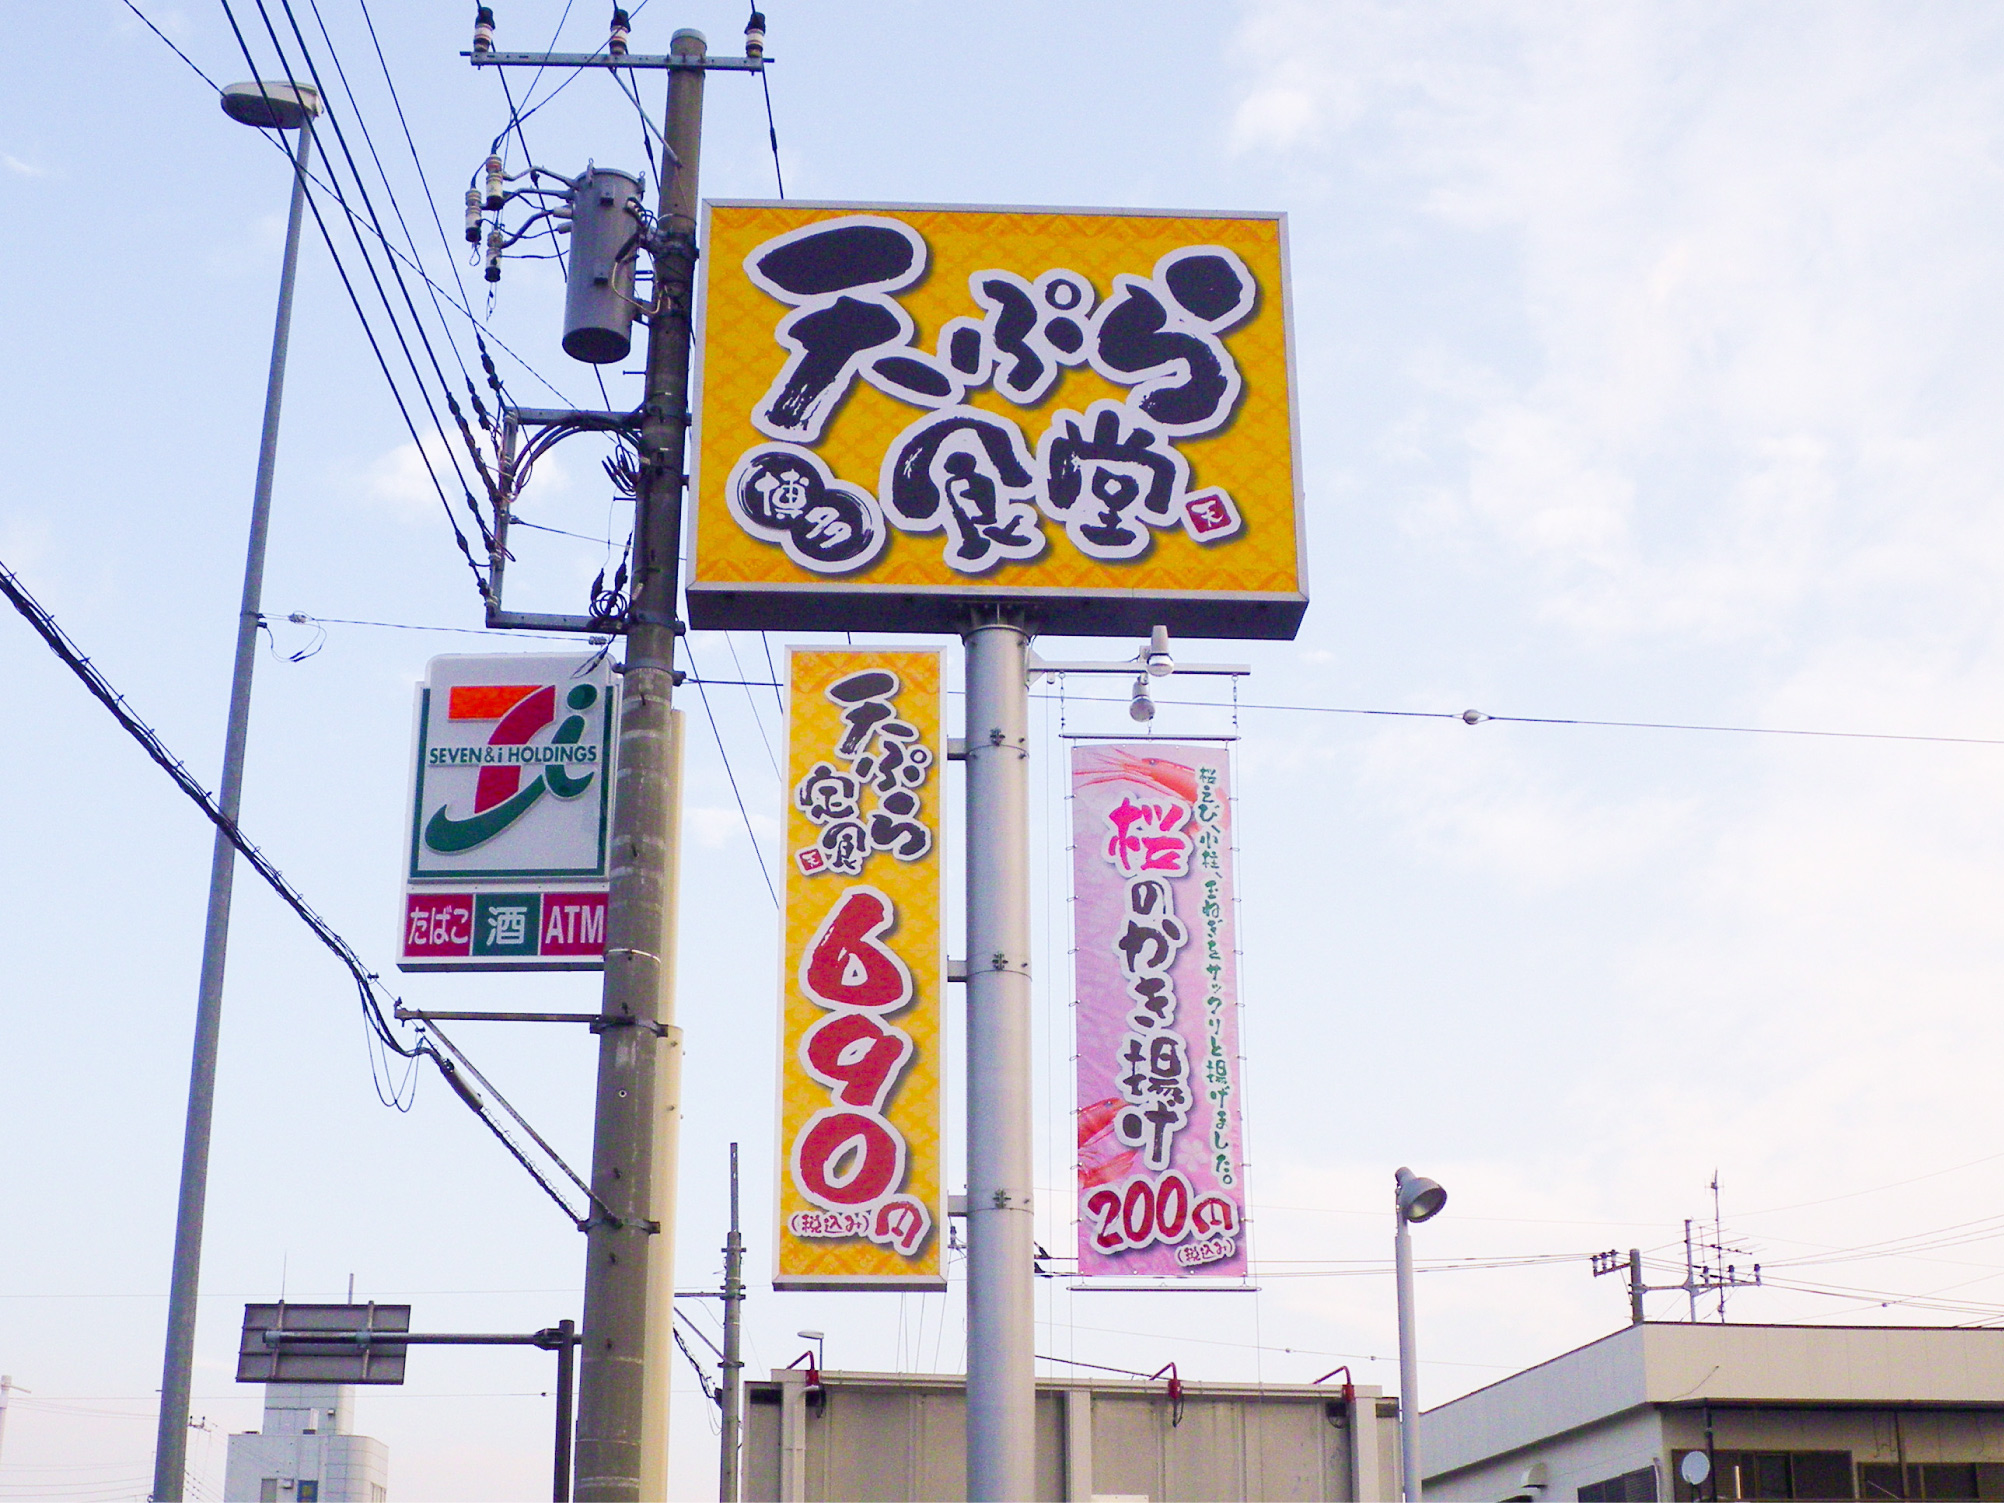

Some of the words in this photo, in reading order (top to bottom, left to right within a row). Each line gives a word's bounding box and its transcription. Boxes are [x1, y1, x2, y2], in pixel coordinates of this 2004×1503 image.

[756, 225, 1243, 430] 天ぷら
[754, 468, 852, 549] 博多
[892, 408, 1178, 560] 食堂
[429, 747, 482, 764] SEVEN
[484, 747, 495, 763] &
[497, 748, 503, 763] i
[508, 746, 597, 763] HOLDINGS
[829, 672, 927, 856] 天ぷら
[800, 765, 866, 870] 定食
[408, 906, 469, 945] たばこ
[486, 906, 528, 945] 酒
[545, 905, 604, 944] ATM
